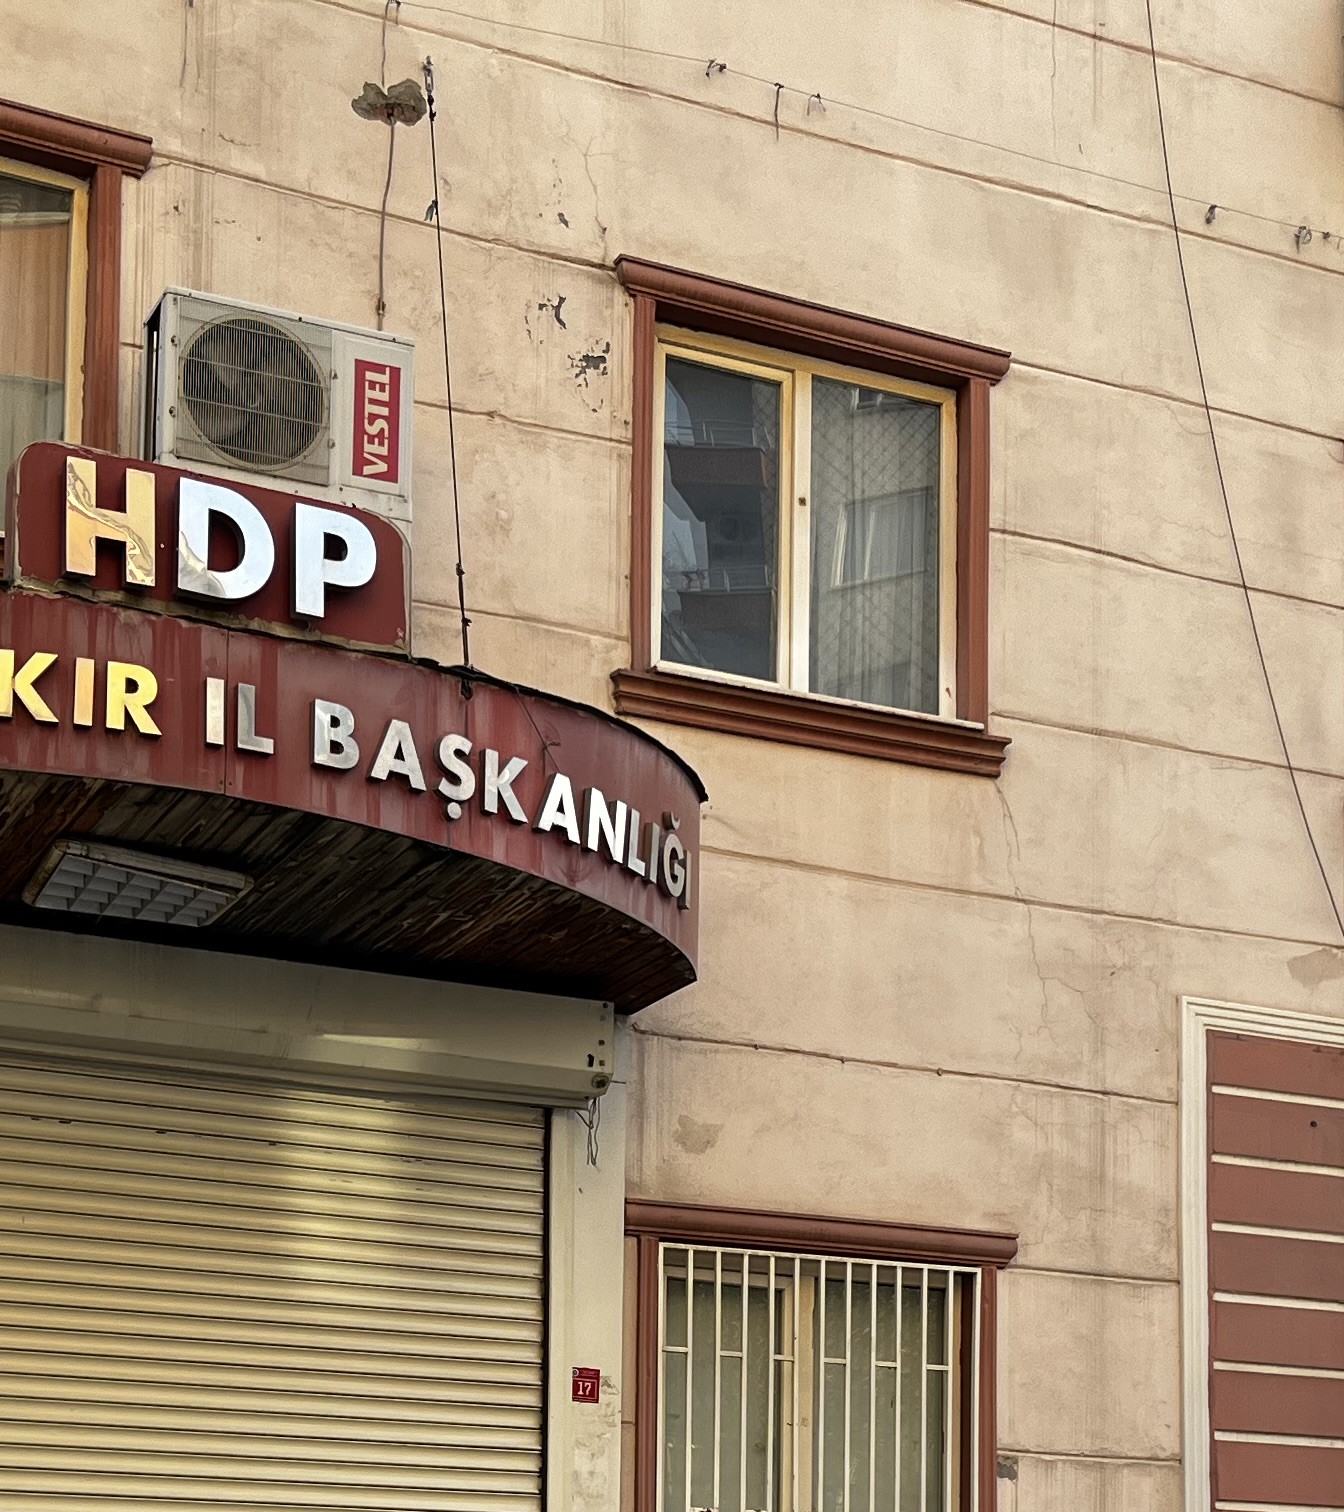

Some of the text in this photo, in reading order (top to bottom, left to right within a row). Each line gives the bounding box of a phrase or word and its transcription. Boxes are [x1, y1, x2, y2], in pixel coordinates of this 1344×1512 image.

[362, 366, 390, 476] VESTEL
[65, 457, 378, 620] HDP
[311, 698, 692, 910] BAŞKANLIĞI
[577, 1381, 591, 1395] 17
